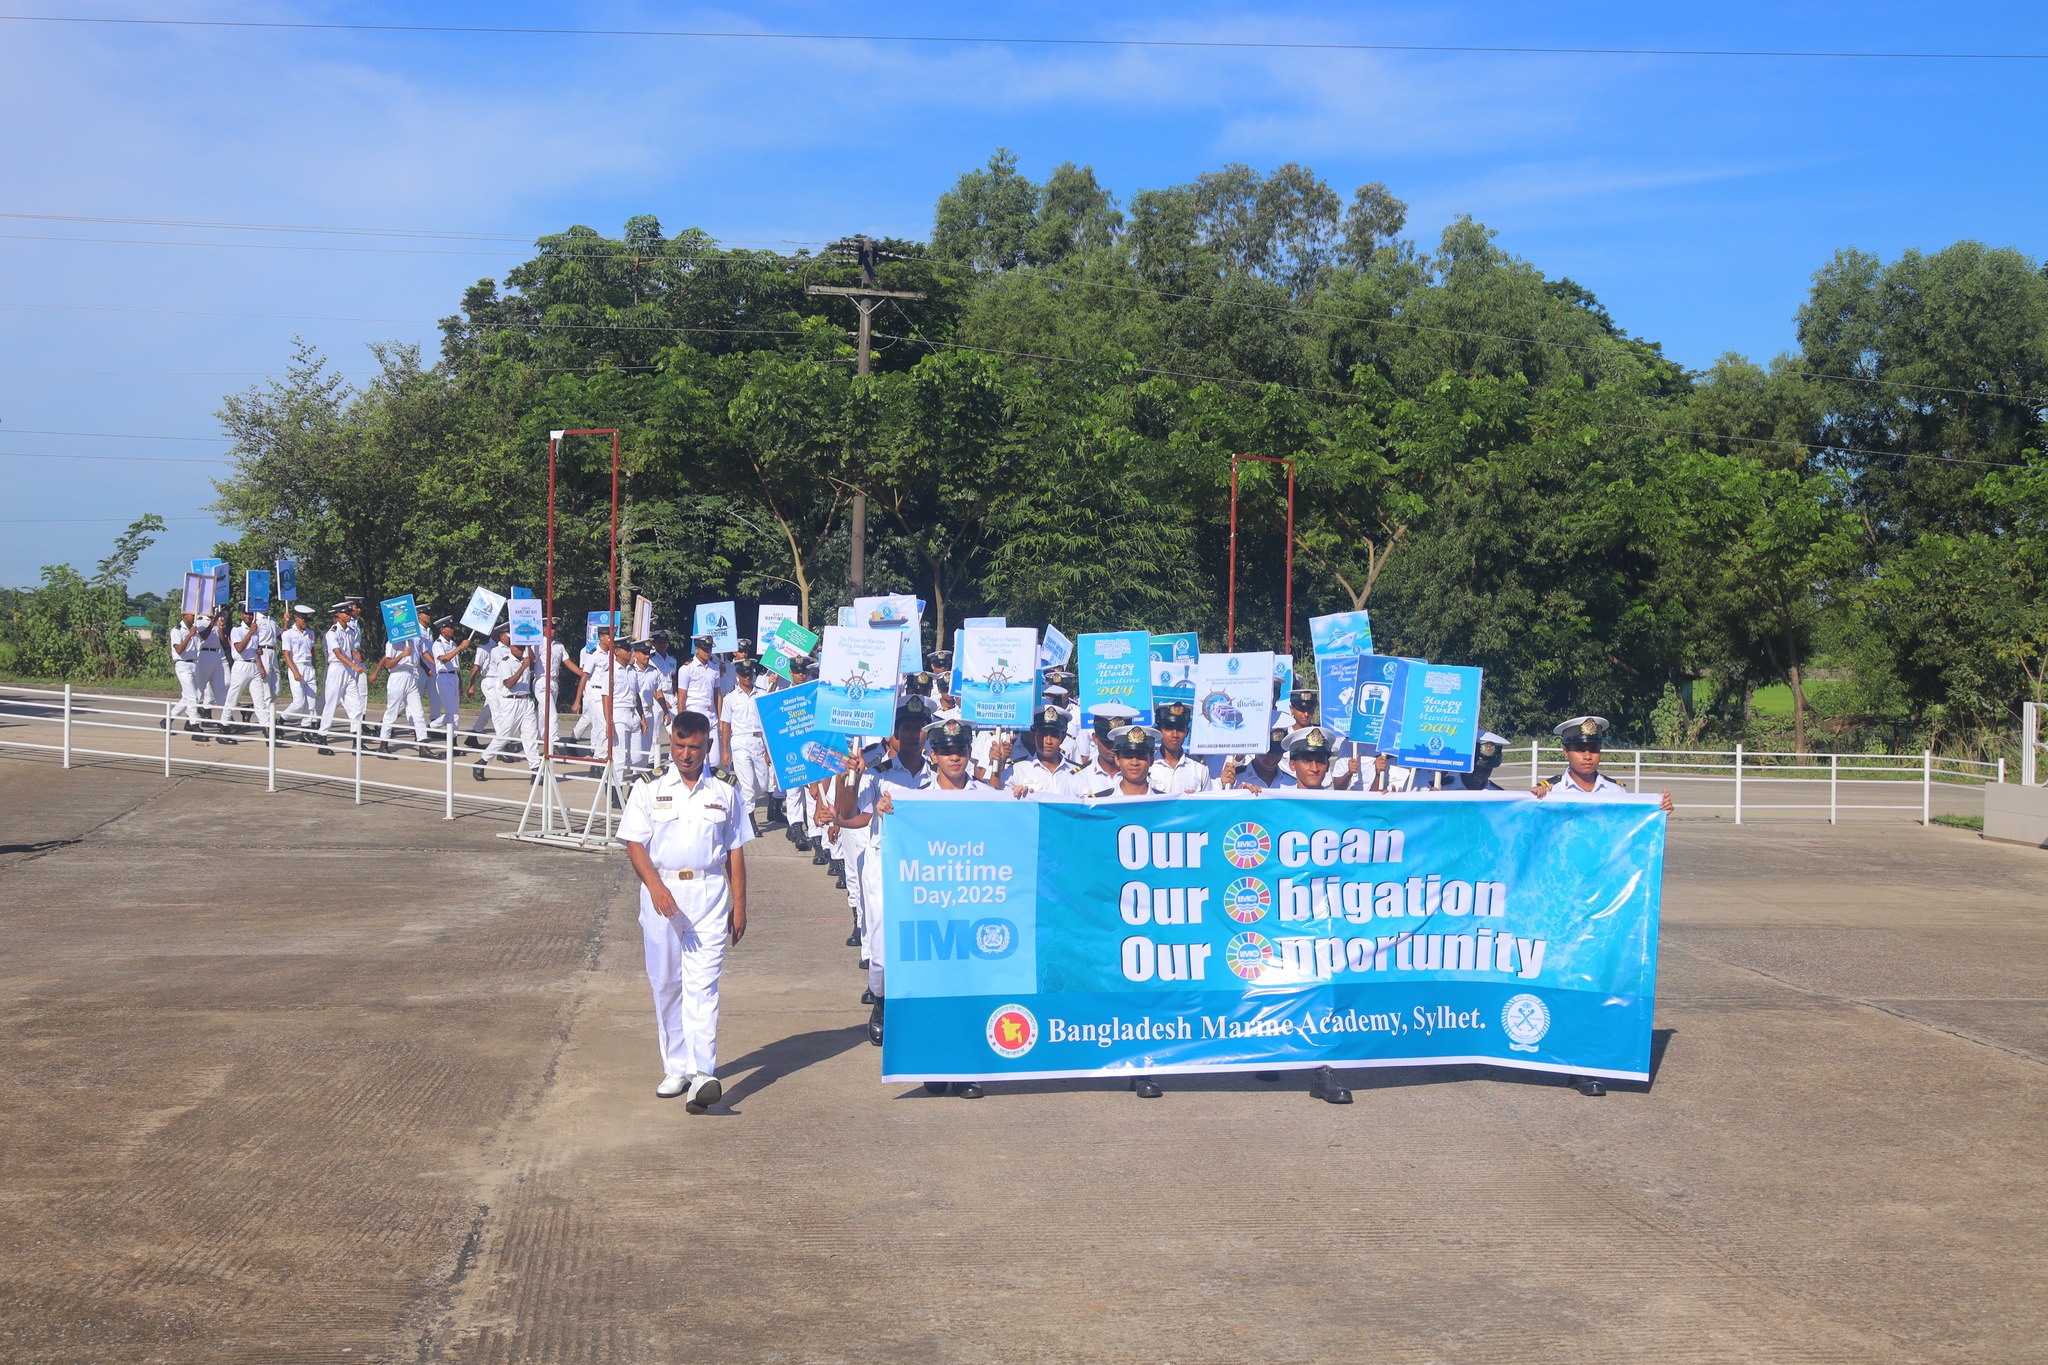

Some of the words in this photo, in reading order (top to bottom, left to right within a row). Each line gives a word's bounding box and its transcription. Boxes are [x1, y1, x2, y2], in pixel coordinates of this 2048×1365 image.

[1096, 662, 1135, 671] Happy
[1098, 669, 1133, 677] World
[1091, 677, 1141, 686] Maritime
[1097, 685, 1134, 696] DAY
[976, 702, 996, 711] Happy
[996, 703, 1016, 711] World
[1422, 696, 1463, 708] Happy
[787, 708, 807, 719] Seas
[832, 708, 853, 718] Happy
[853, 710, 874, 719] World
[976, 711, 1003, 719] Maritime
[1424, 705, 1460, 715] World
[830, 717, 860, 727] Maritime
[860, 720, 873, 729] Day
[1415, 712, 1466, 723] Maritime
[1420, 722, 1458, 737] DAY
[927, 840, 985, 857] World
[1117, 824, 1209, 871] Our
[1278, 827, 1405, 868] cean
[899, 859, 1013, 882] Maritime
[913, 885, 1007, 909] Day,2025
[1119, 880, 1210, 926] Our
[899, 917, 1020, 962] IMO
[1120, 935, 1211, 982] Our
[1048, 1015, 1192, 1047] Bangladesh
[1200, 1014, 1294, 1040] Marine
[1302, 1007, 1408, 1036] Academy,
[1412, 1005, 1486, 1036] Sylhet.
